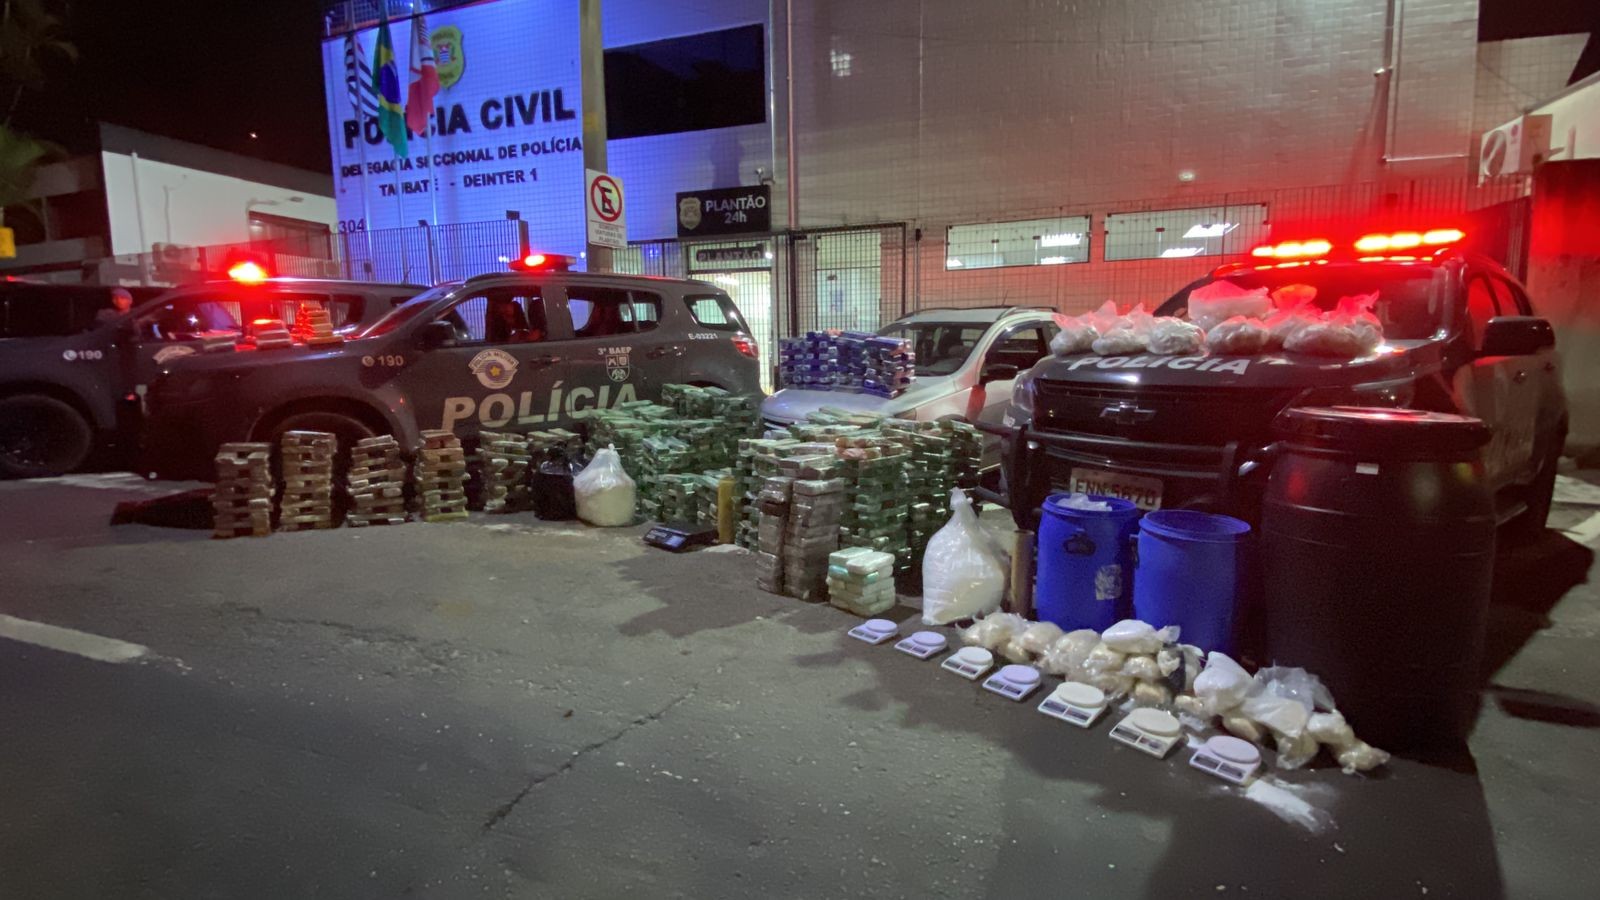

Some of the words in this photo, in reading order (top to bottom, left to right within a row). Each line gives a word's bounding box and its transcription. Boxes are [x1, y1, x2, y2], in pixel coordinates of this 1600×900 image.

[344, 104, 472, 149] POIA
[480, 88, 576, 131] CIVIL
[498, 144, 518, 160] DE
[521, 136, 582, 157] POLÍCIA
[463, 169, 526, 188] DEINTER
[529, 168, 538, 182] 1
[704, 193, 767, 213] PLANTÃO
[338, 217, 365, 235] 304
[724, 210, 748, 224] 24h
[77, 350, 103, 360] 190
[377, 354, 404, 367] 190
[440, 380, 639, 434] POLÍCIA
